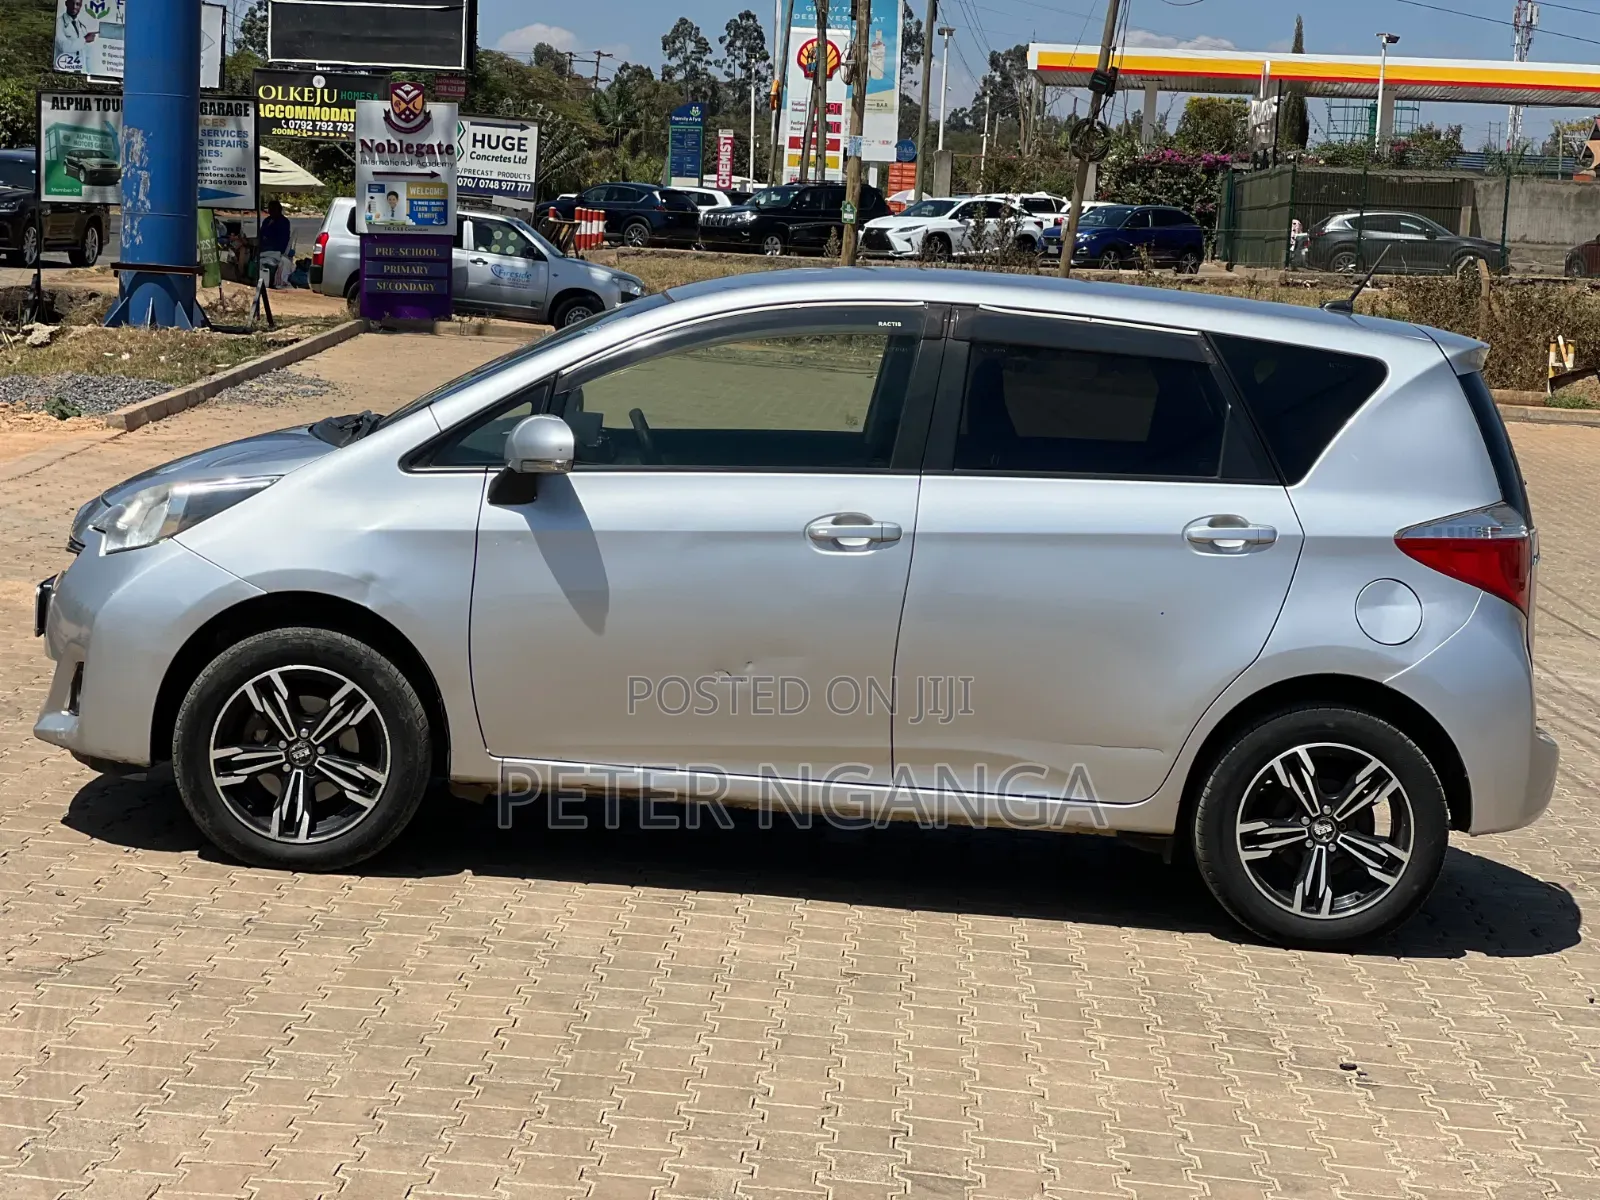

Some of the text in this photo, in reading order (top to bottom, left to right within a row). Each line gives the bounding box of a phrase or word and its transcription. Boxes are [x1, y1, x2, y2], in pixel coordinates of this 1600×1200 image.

[67, 56, 80, 65] 24
[258, 85, 338, 106] OLKEJU
[50, 96, 250, 117] ALPHA TOU GARAGE
[288, 120, 354, 132] 0792 792 792
[201, 129, 249, 138] SERVICES
[207, 139, 250, 149] REPAIRS
[359, 139, 455, 158] Noblegate
[472, 133, 528, 153] HUGE
[360, 158, 455, 169] International Academy
[470, 151, 528, 165] Concretes Ltd
[718, 137, 732, 188] CHEMIST
[497, 172, 531, 180] PRODUCTS
[409, 187, 444, 196] WELCOME
[479, 180, 499, 189] 0748
[501, 181, 515, 191] 977
[517, 183, 531, 192] 777
[375, 247, 439, 257] PRE-SCHOOL
[383, 265, 429, 274] PRIMARY
[376, 282, 436, 292] SECONDARY
